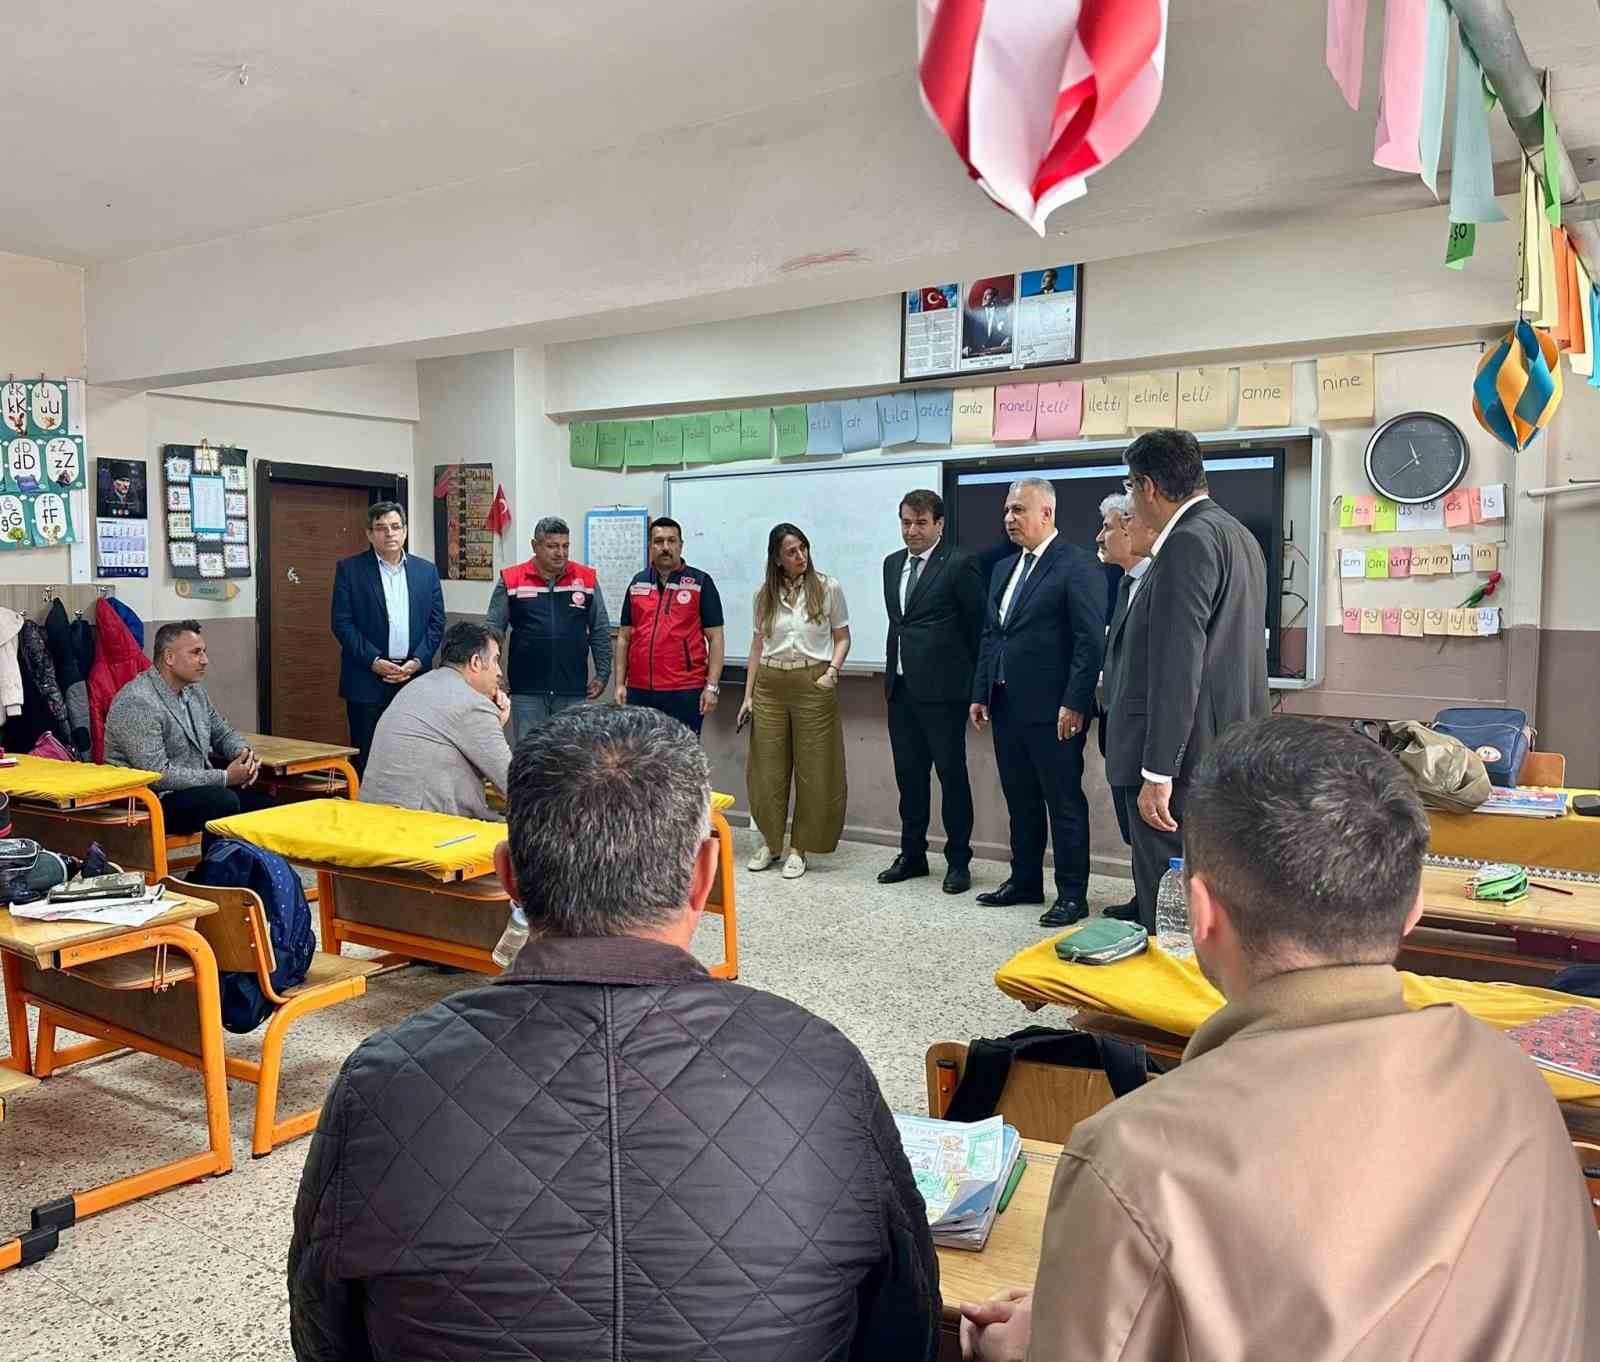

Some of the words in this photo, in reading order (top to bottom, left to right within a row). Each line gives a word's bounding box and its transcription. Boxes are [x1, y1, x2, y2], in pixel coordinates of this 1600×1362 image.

[959, 401, 984, 415] anla
[1135, 387, 1169, 403] elinle
[1181, 385, 1210, 402] elli
[1242, 386, 1281, 400] anne
[1322, 373, 1361, 393] nine
[8, 398, 27, 413] kK
[41, 400, 59, 414] uU
[13, 454, 36, 469] dD
[55, 452, 75, 468] zZ
[42, 508, 58, 524] fF
